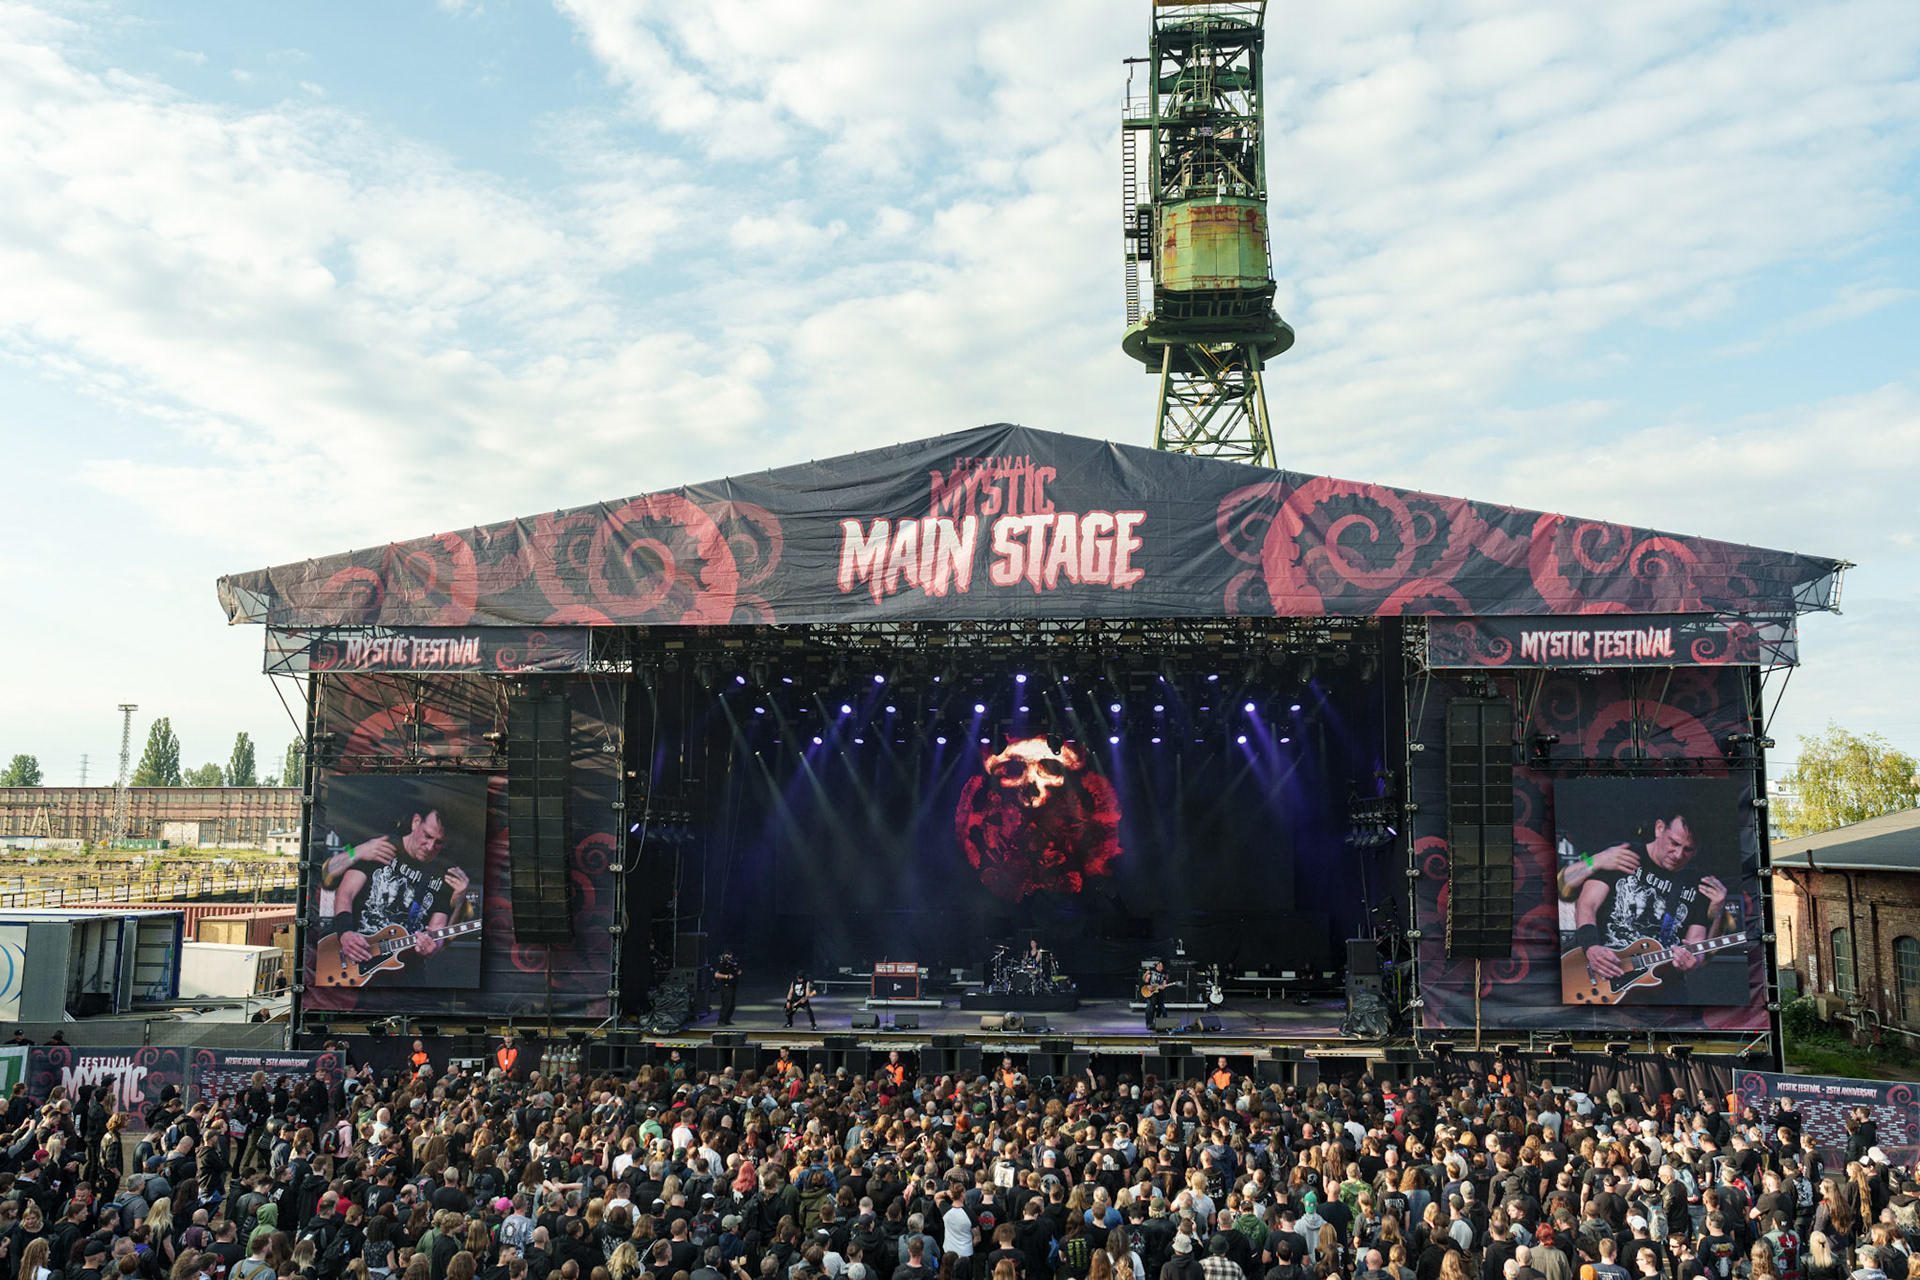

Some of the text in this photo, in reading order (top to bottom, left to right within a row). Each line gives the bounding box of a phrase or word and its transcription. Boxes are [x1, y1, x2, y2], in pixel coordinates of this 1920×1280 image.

[955, 454, 1036, 470] FESTIVAL
[929, 466, 1057, 518] MYSTIC
[837, 510, 1147, 605] MAIN STAGE
[345, 635, 482, 669] MYSTIC FESTIVAL
[1520, 626, 1675, 663] MYSTIC FESTIVAL
[79, 1055, 134, 1068] FESTIVAL
[1777, 1082, 1797, 1092] MYSTIC
[1798, 1083, 1820, 1093] FESTIVAL
[1826, 1086, 1840, 1095] 25TH
[1840, 1087, 1877, 1098] ANNIVERSARY
